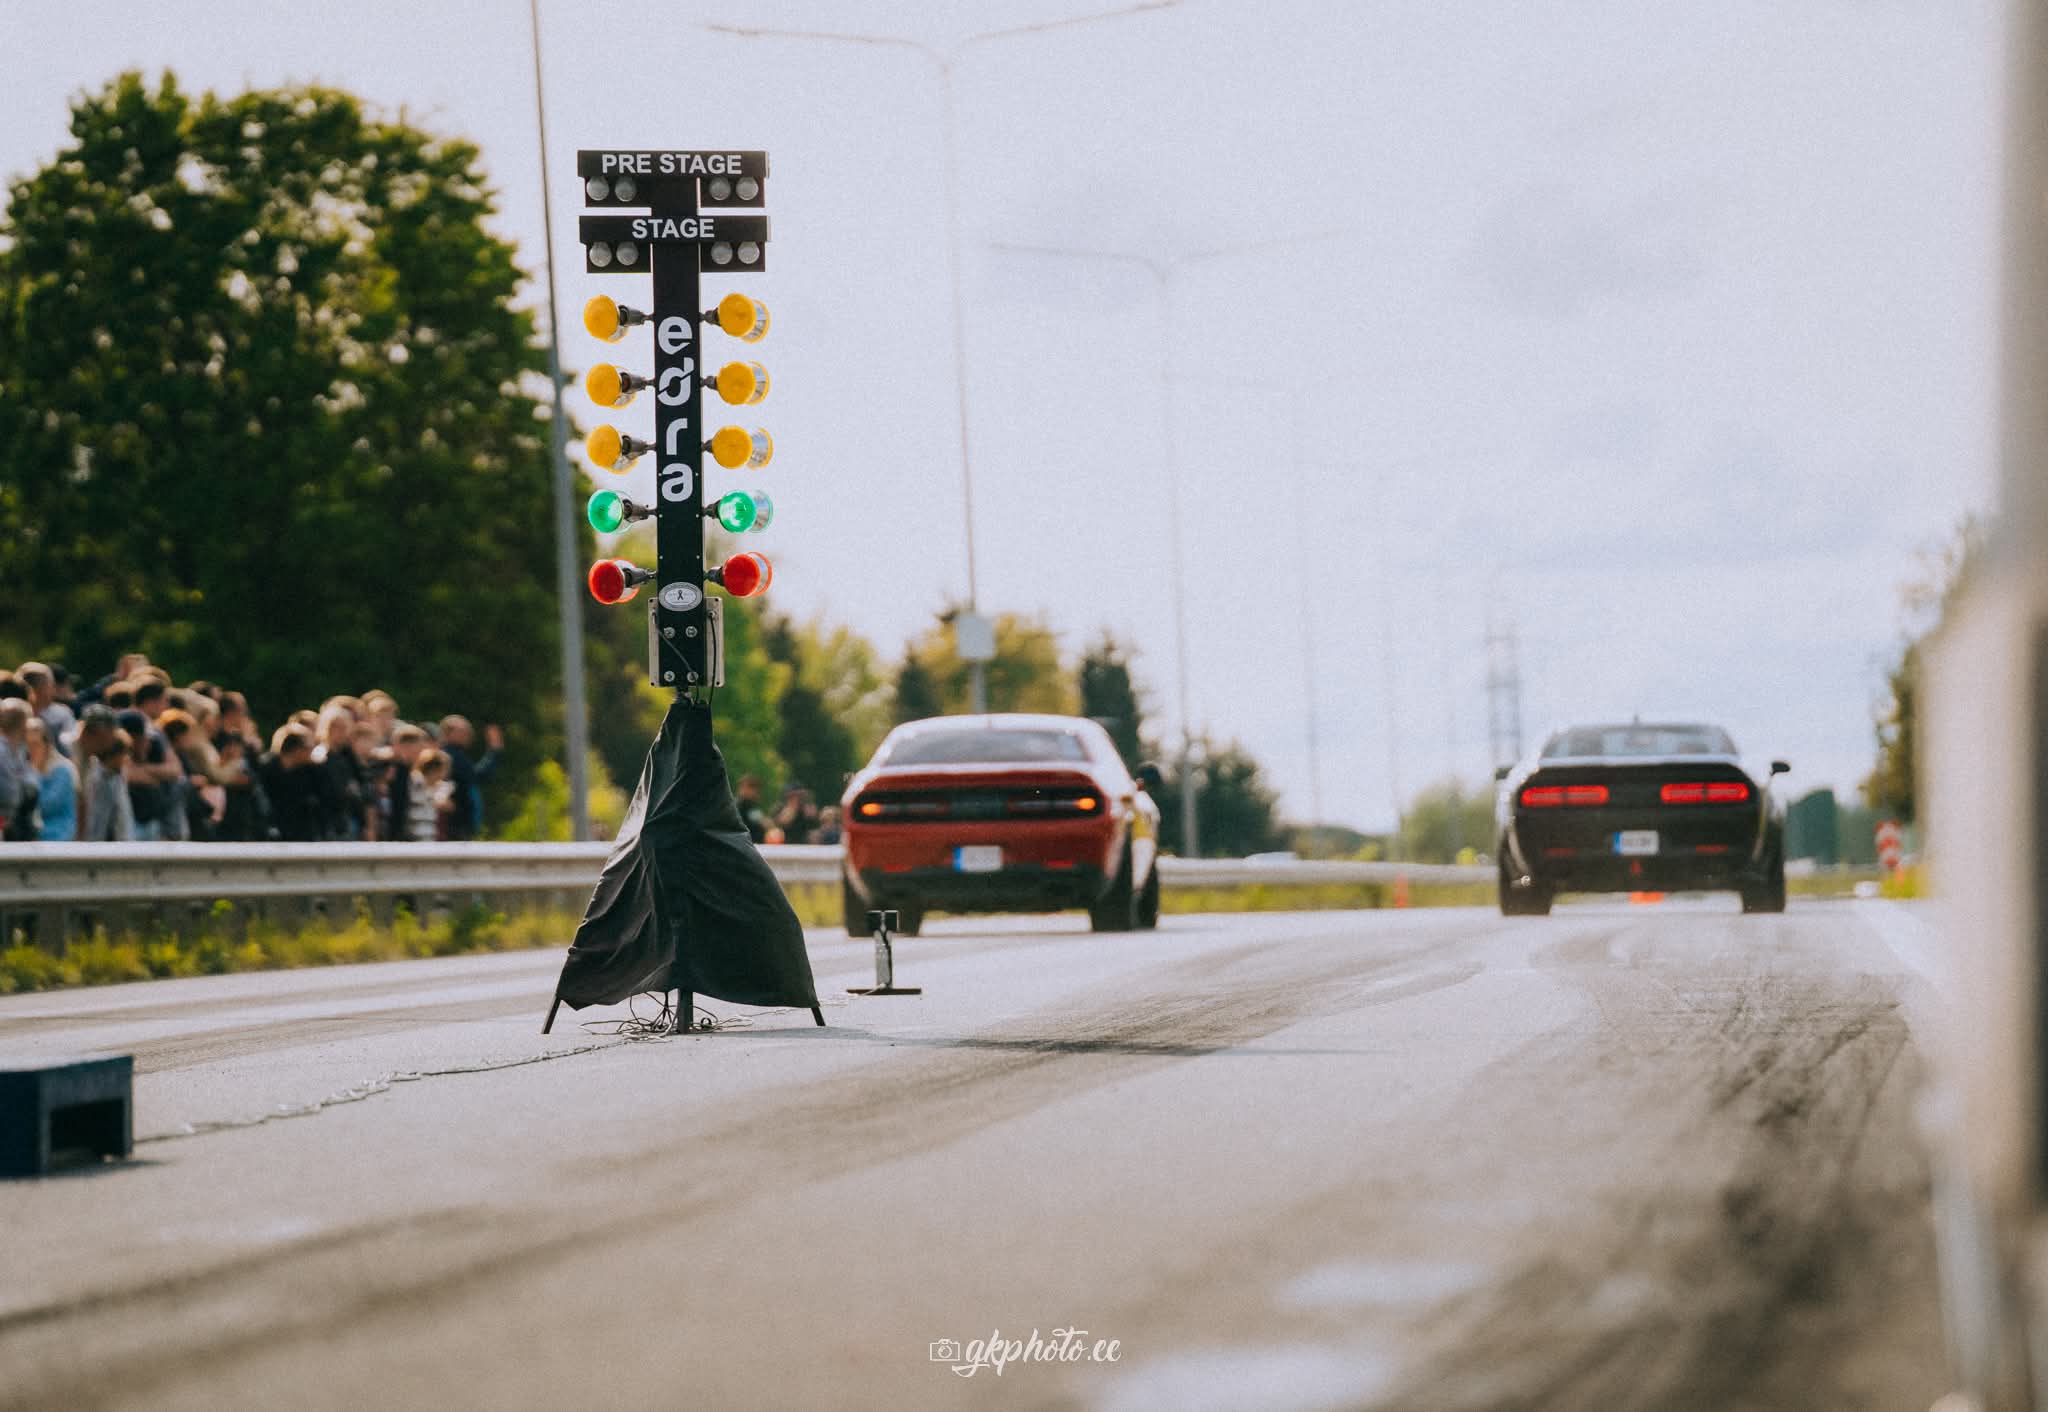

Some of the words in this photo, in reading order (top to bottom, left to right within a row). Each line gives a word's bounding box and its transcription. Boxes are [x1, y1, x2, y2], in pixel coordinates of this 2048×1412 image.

[602, 154, 652, 174] PRE
[659, 154, 742, 175] STAGE
[632, 218, 715, 239] STAGE
[657, 316, 694, 502] edra
